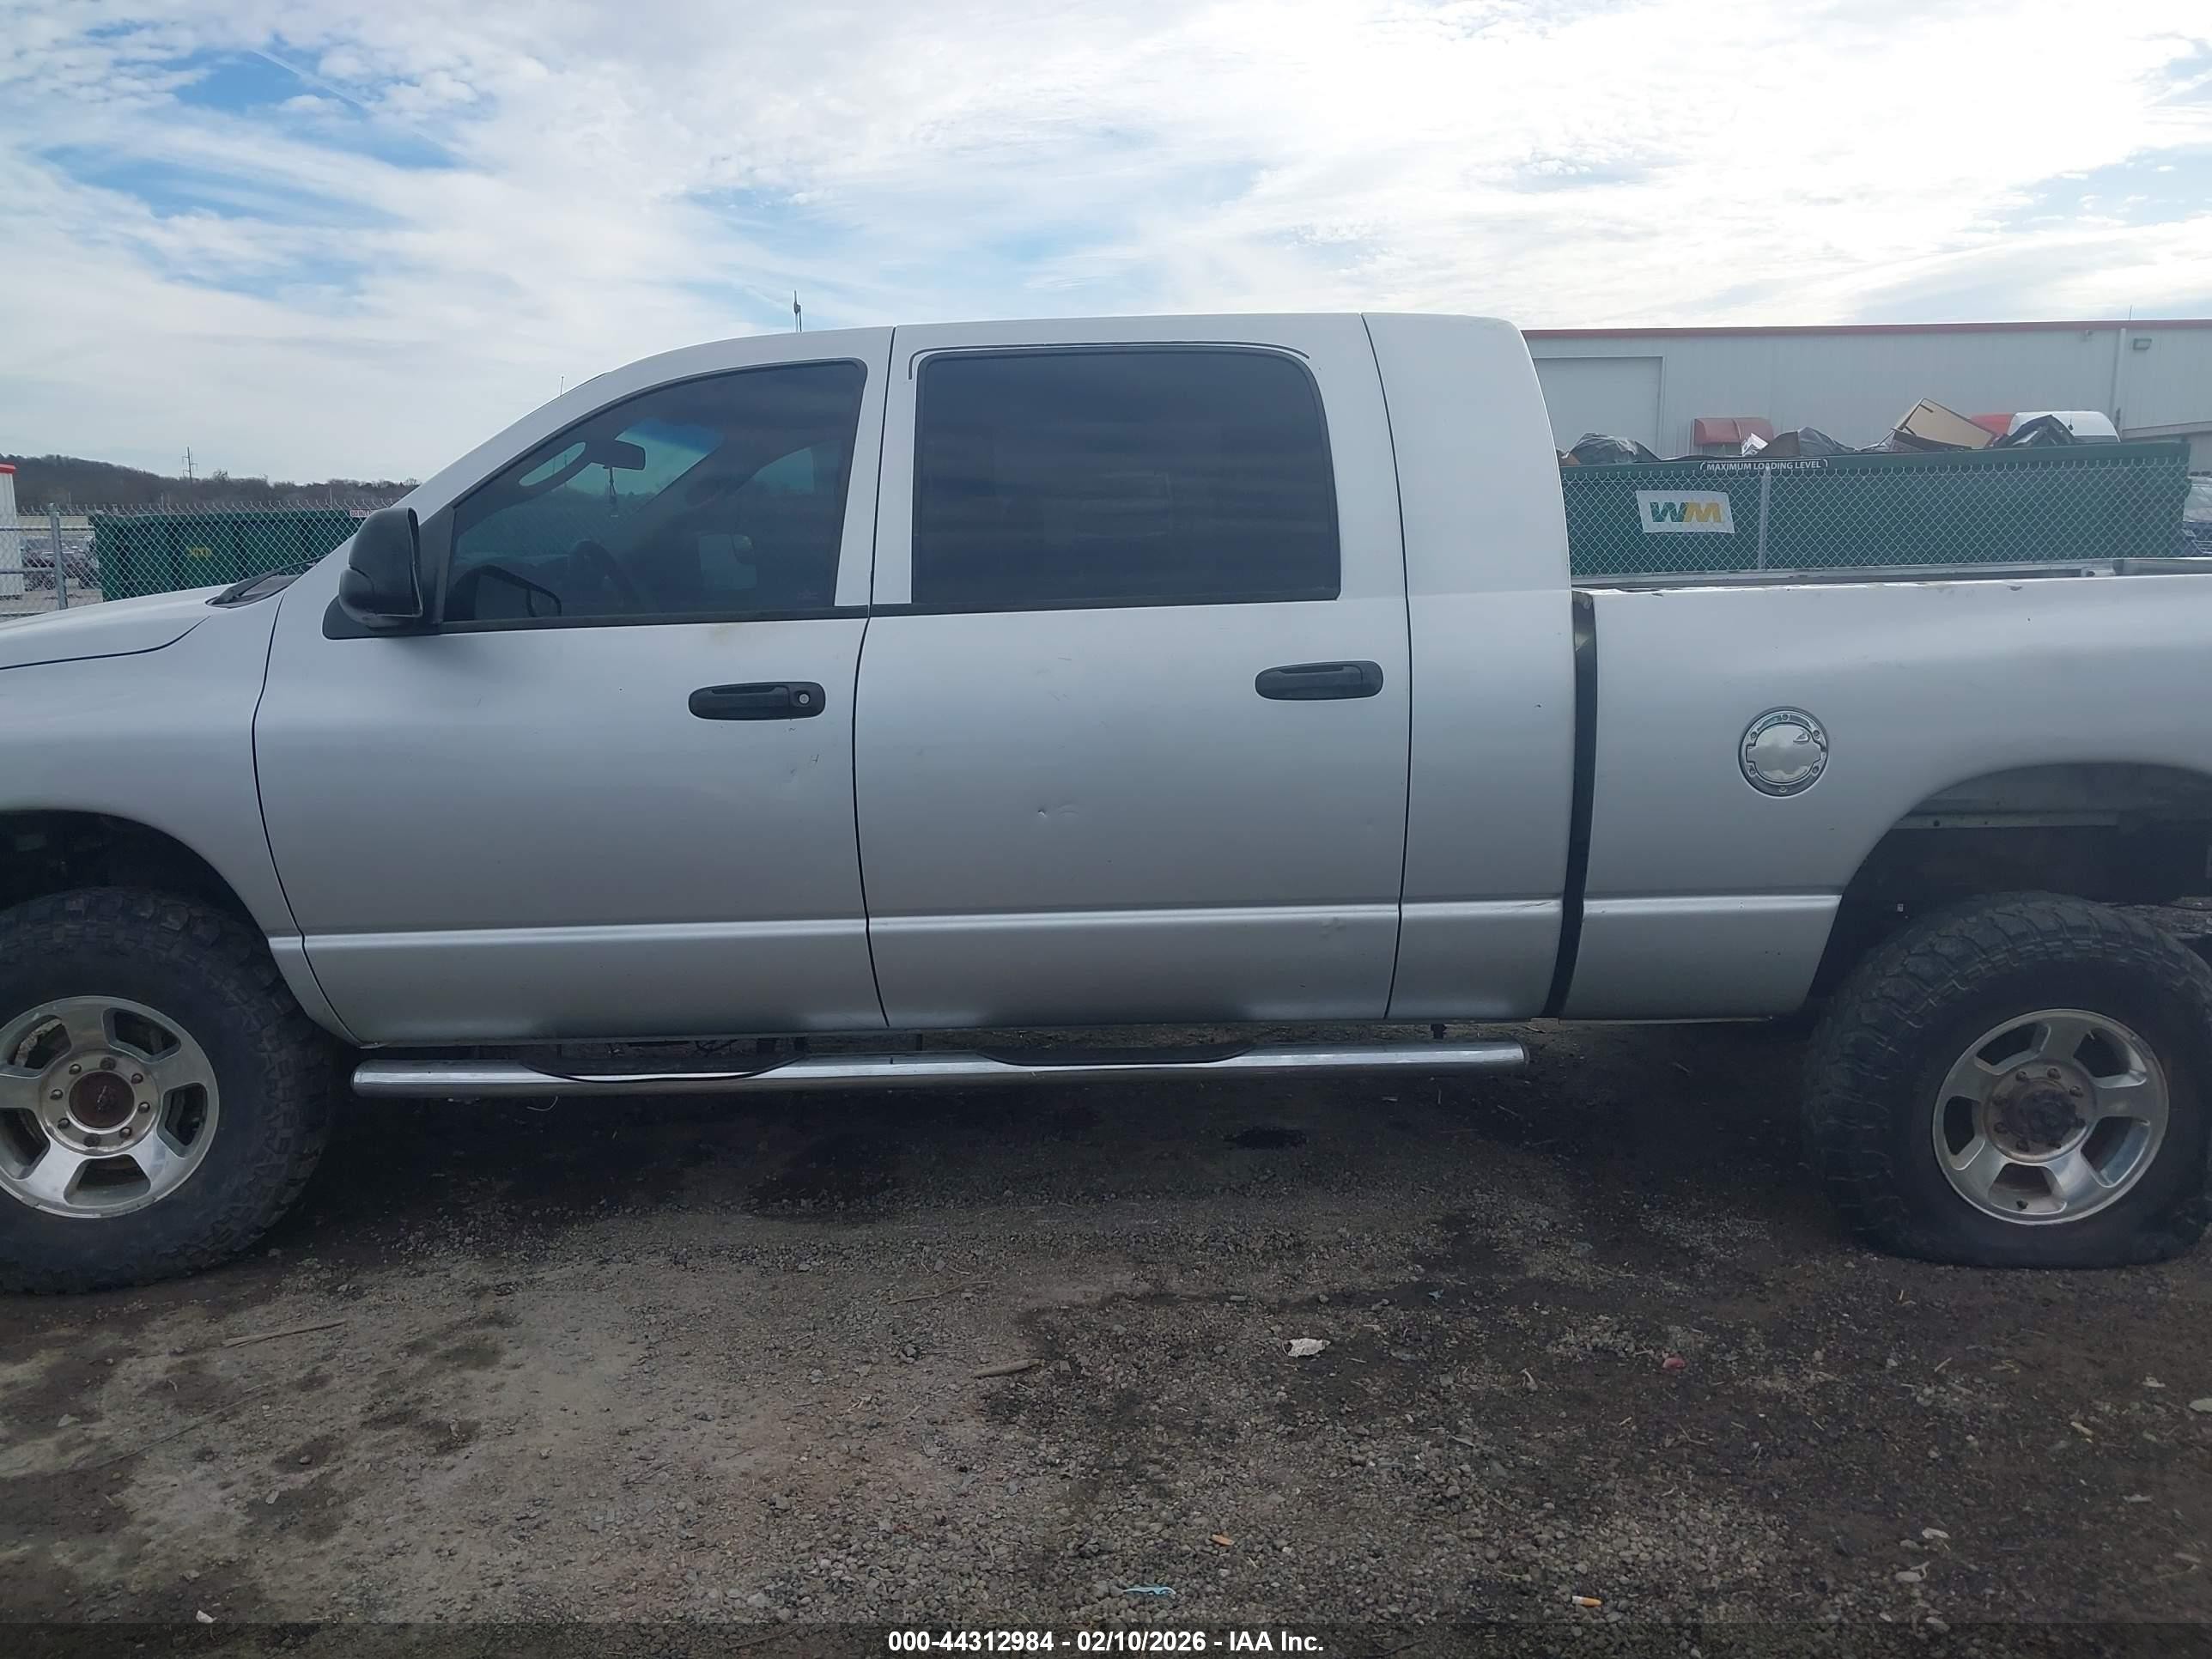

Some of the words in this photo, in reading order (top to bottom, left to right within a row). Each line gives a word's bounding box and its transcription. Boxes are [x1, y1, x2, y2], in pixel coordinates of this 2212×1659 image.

[1706, 461, 1752, 471] MAXIMUM
[1753, 461, 1794, 471] LOADING
[1795, 459, 1821, 469] LEVEL
[1649, 501, 1722, 523] WM
